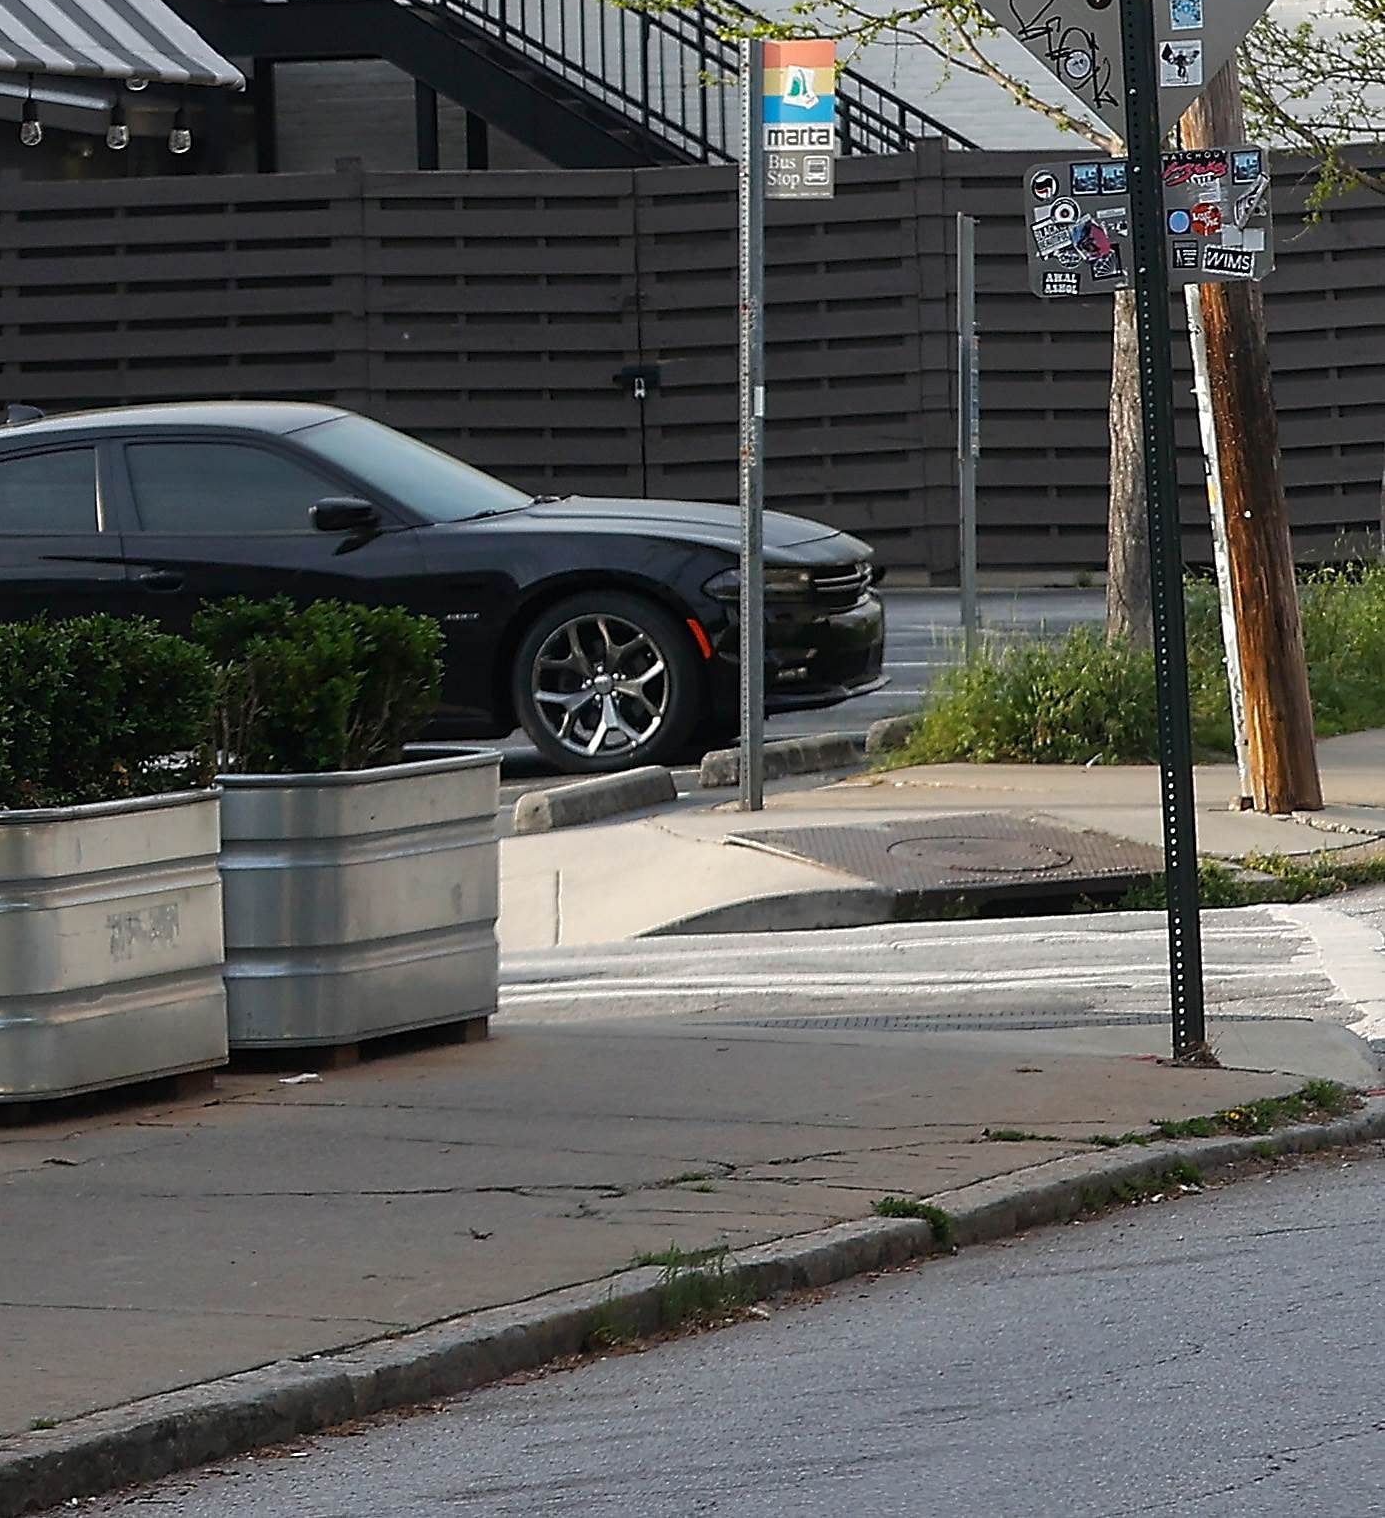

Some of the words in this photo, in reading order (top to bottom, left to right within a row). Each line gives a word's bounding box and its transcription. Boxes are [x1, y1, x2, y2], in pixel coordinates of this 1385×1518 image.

[767, 125, 831, 146] marta
[768, 154, 796, 169] Bus
[1162, 150, 1227, 161] WATCHOU
[767, 170, 800, 190] Stop
[1207, 251, 1250, 270] WIMS
